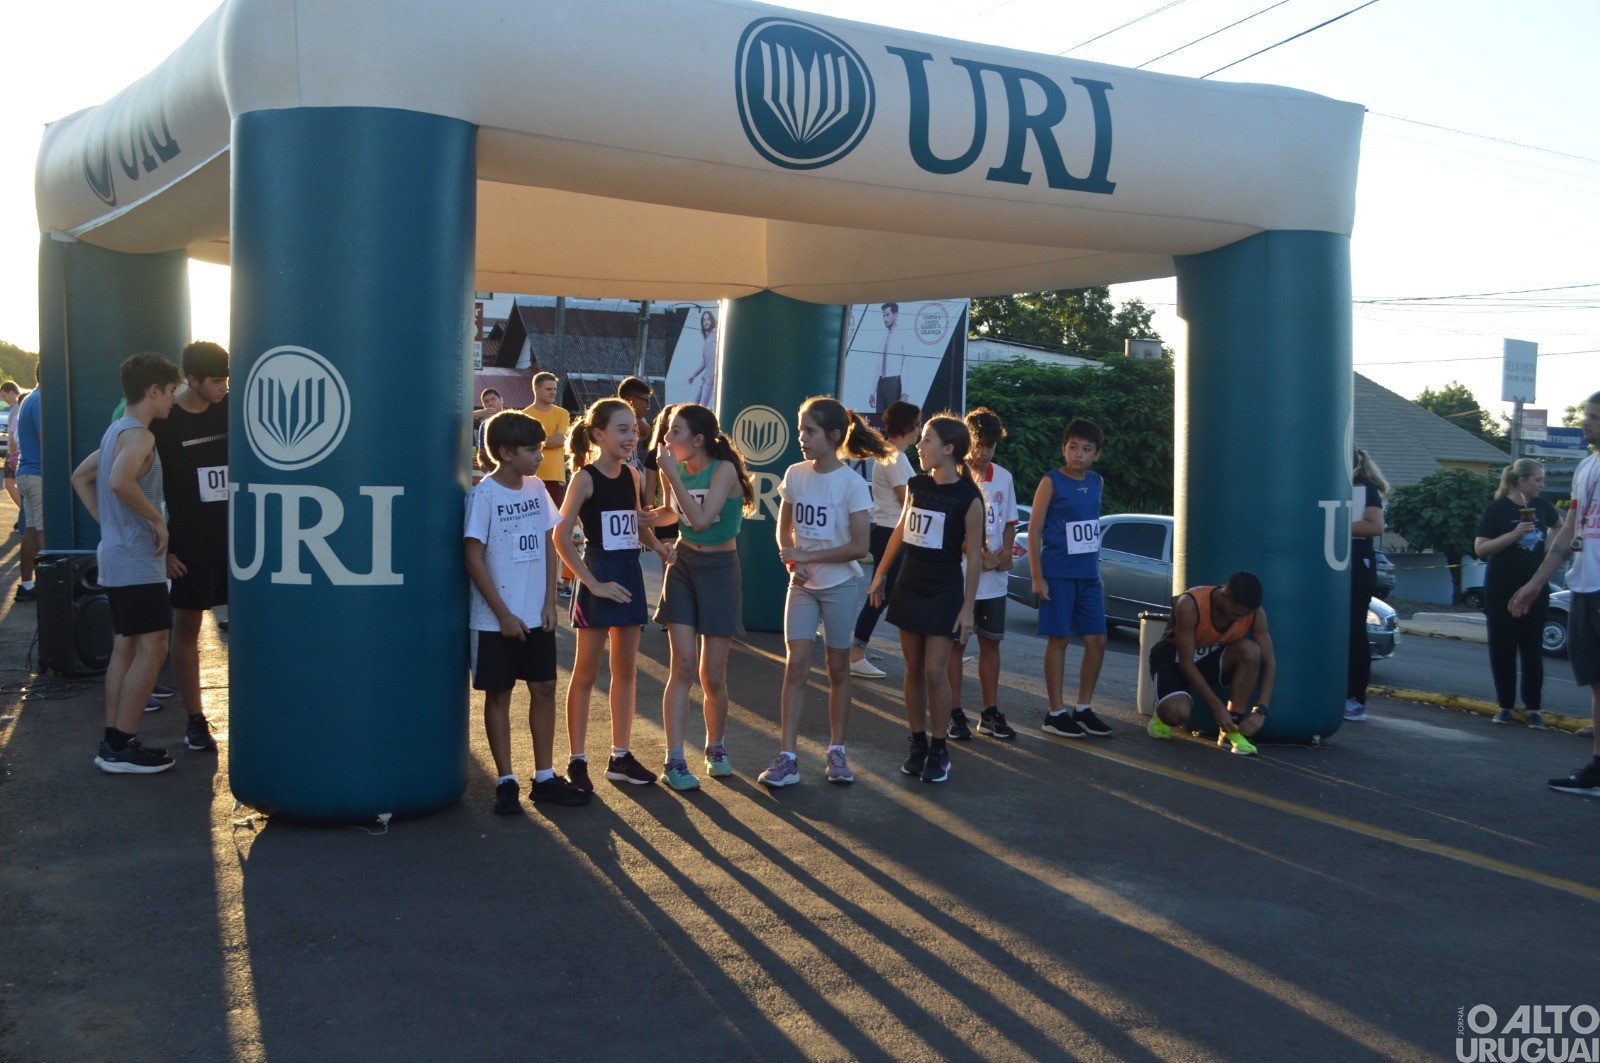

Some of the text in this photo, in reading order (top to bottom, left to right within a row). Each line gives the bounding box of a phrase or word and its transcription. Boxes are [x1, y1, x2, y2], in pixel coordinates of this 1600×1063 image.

[885, 45, 1117, 195] URI
[208, 470, 226, 489] 01
[497, 498, 540, 517] FUTURE
[796, 502, 827, 527] 005
[228, 482, 404, 586] URI
[609, 514, 637, 537] 020
[909, 511, 933, 535] 017
[1073, 523, 1099, 542] 004
[519, 534, 539, 551] 001
